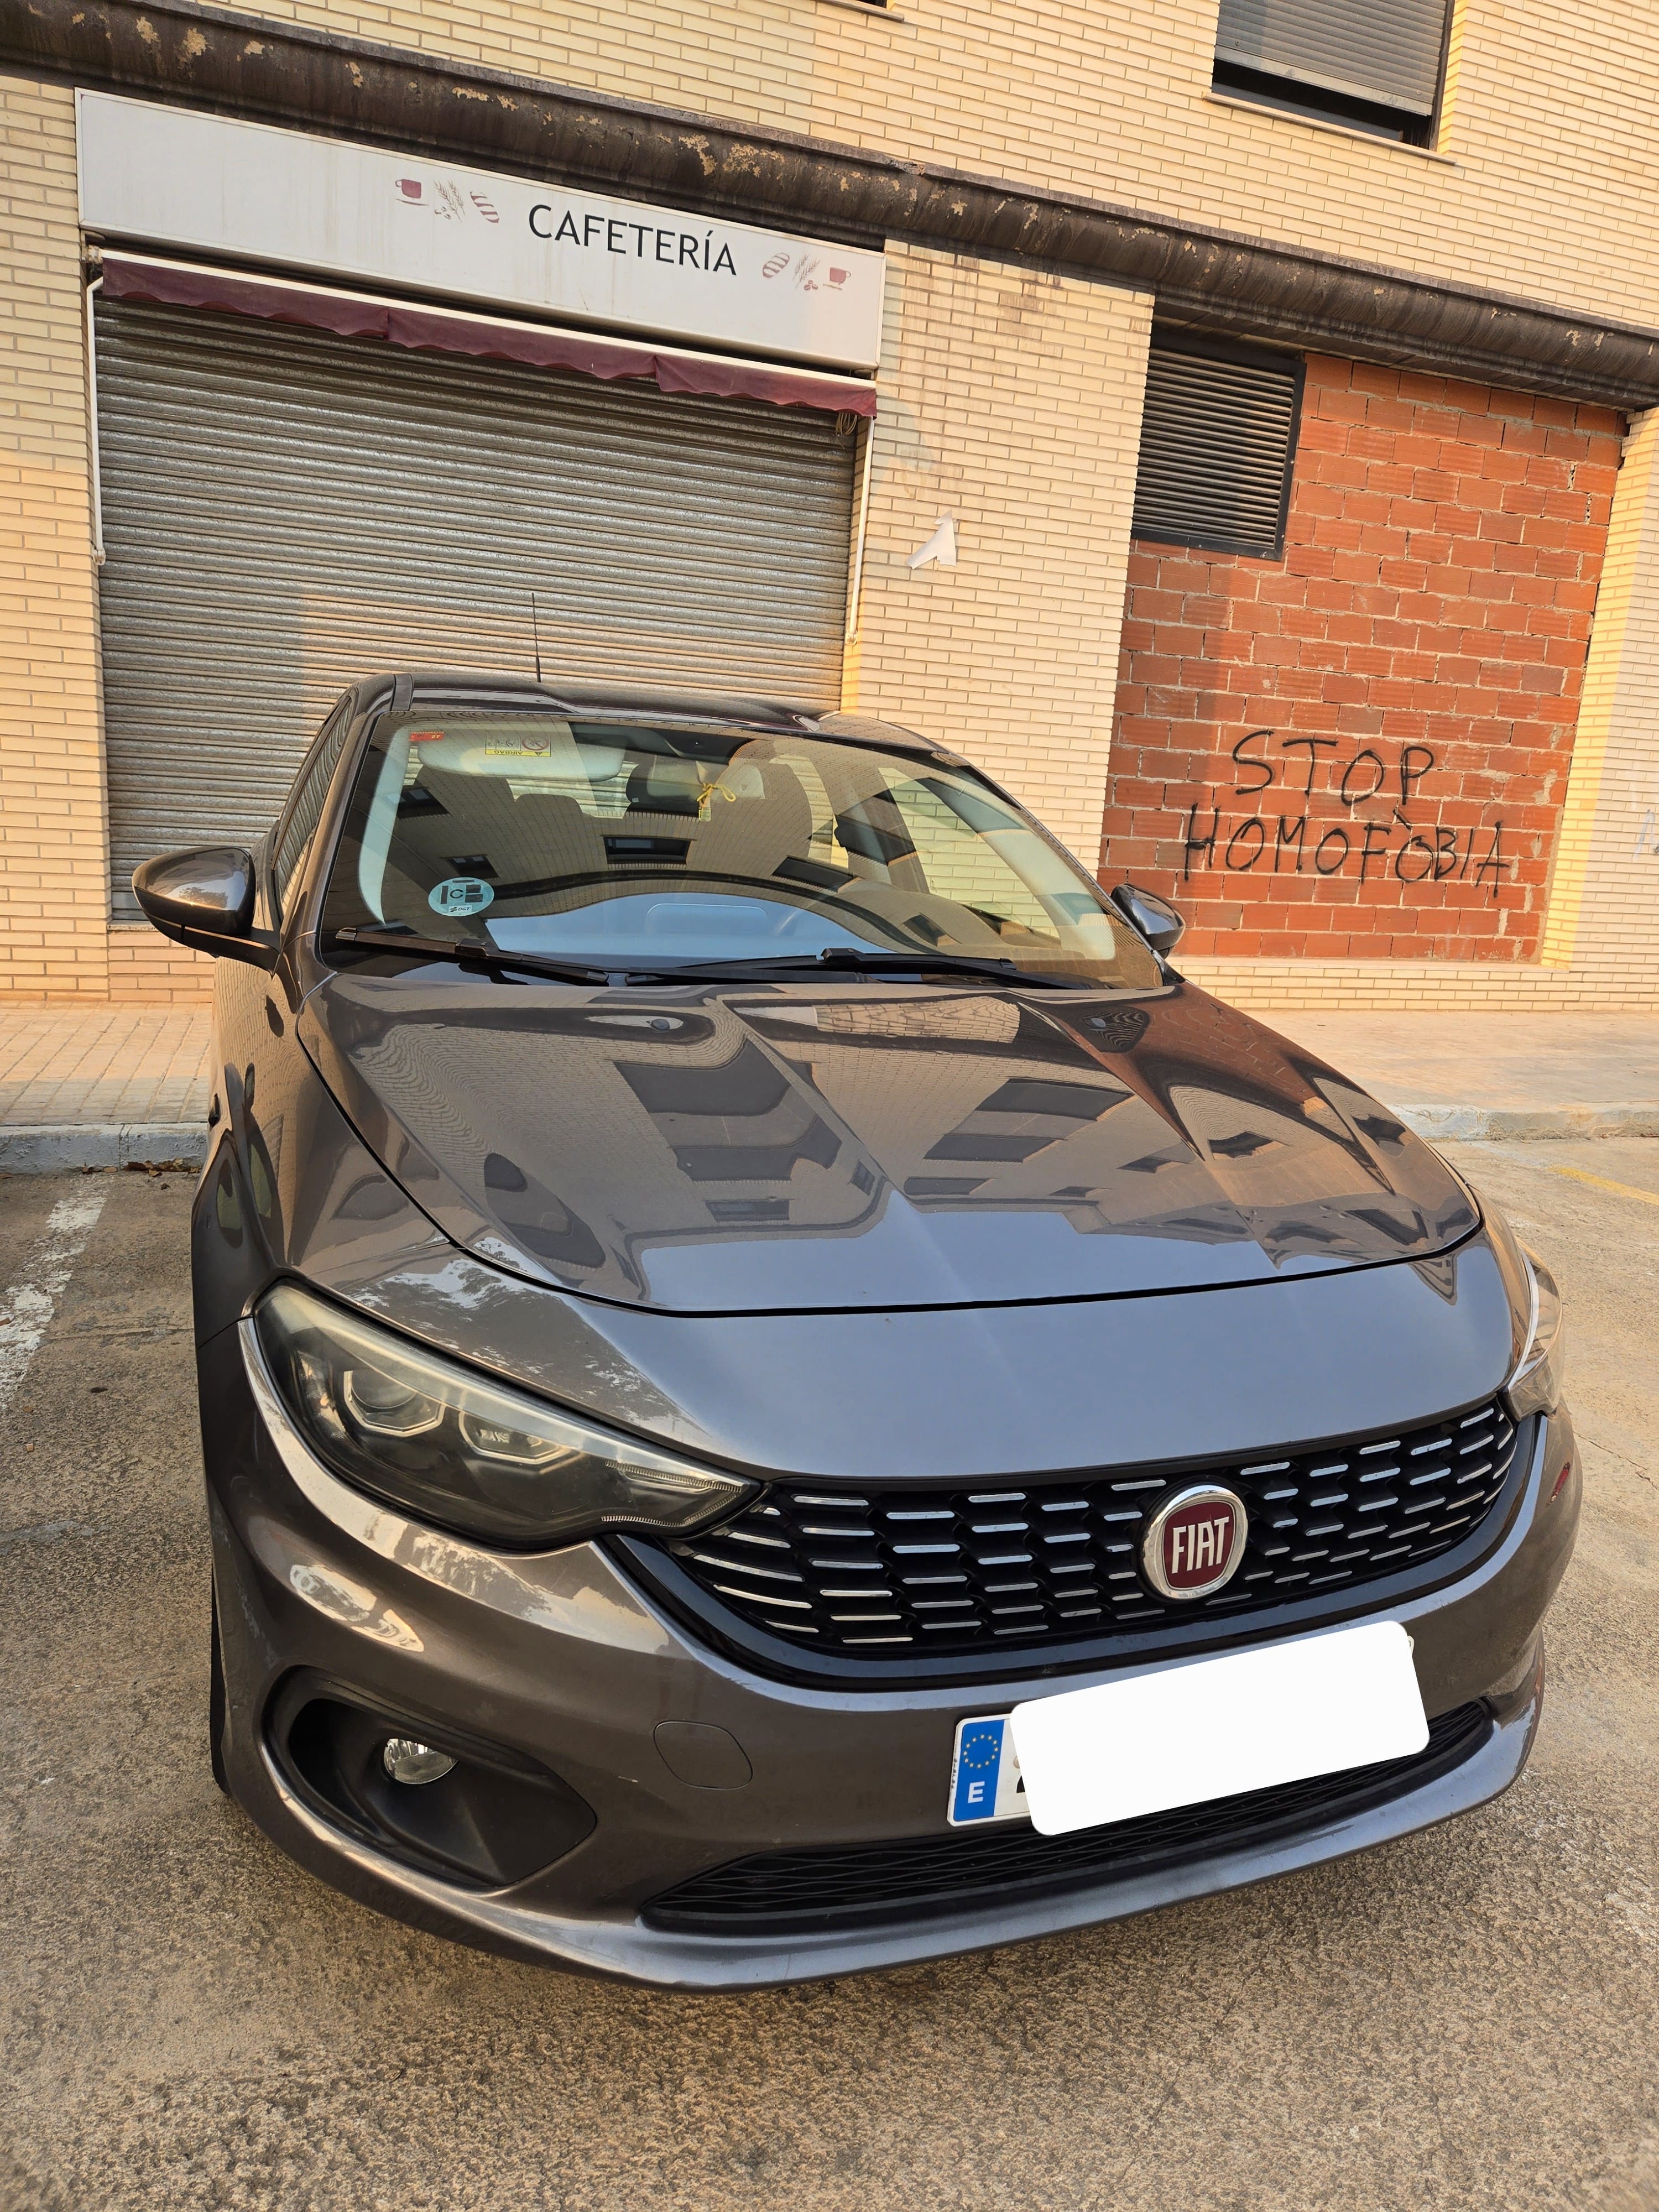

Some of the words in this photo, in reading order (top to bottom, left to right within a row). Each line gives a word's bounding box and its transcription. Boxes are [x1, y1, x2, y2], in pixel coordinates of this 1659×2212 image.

[529, 204, 737, 275] CAFETERÍA
[1232, 729, 1435, 806] STOP
[450, 889, 464, 899] C
[1171, 1516, 1230, 1574] FIAT
[968, 1781, 985, 1804] E
